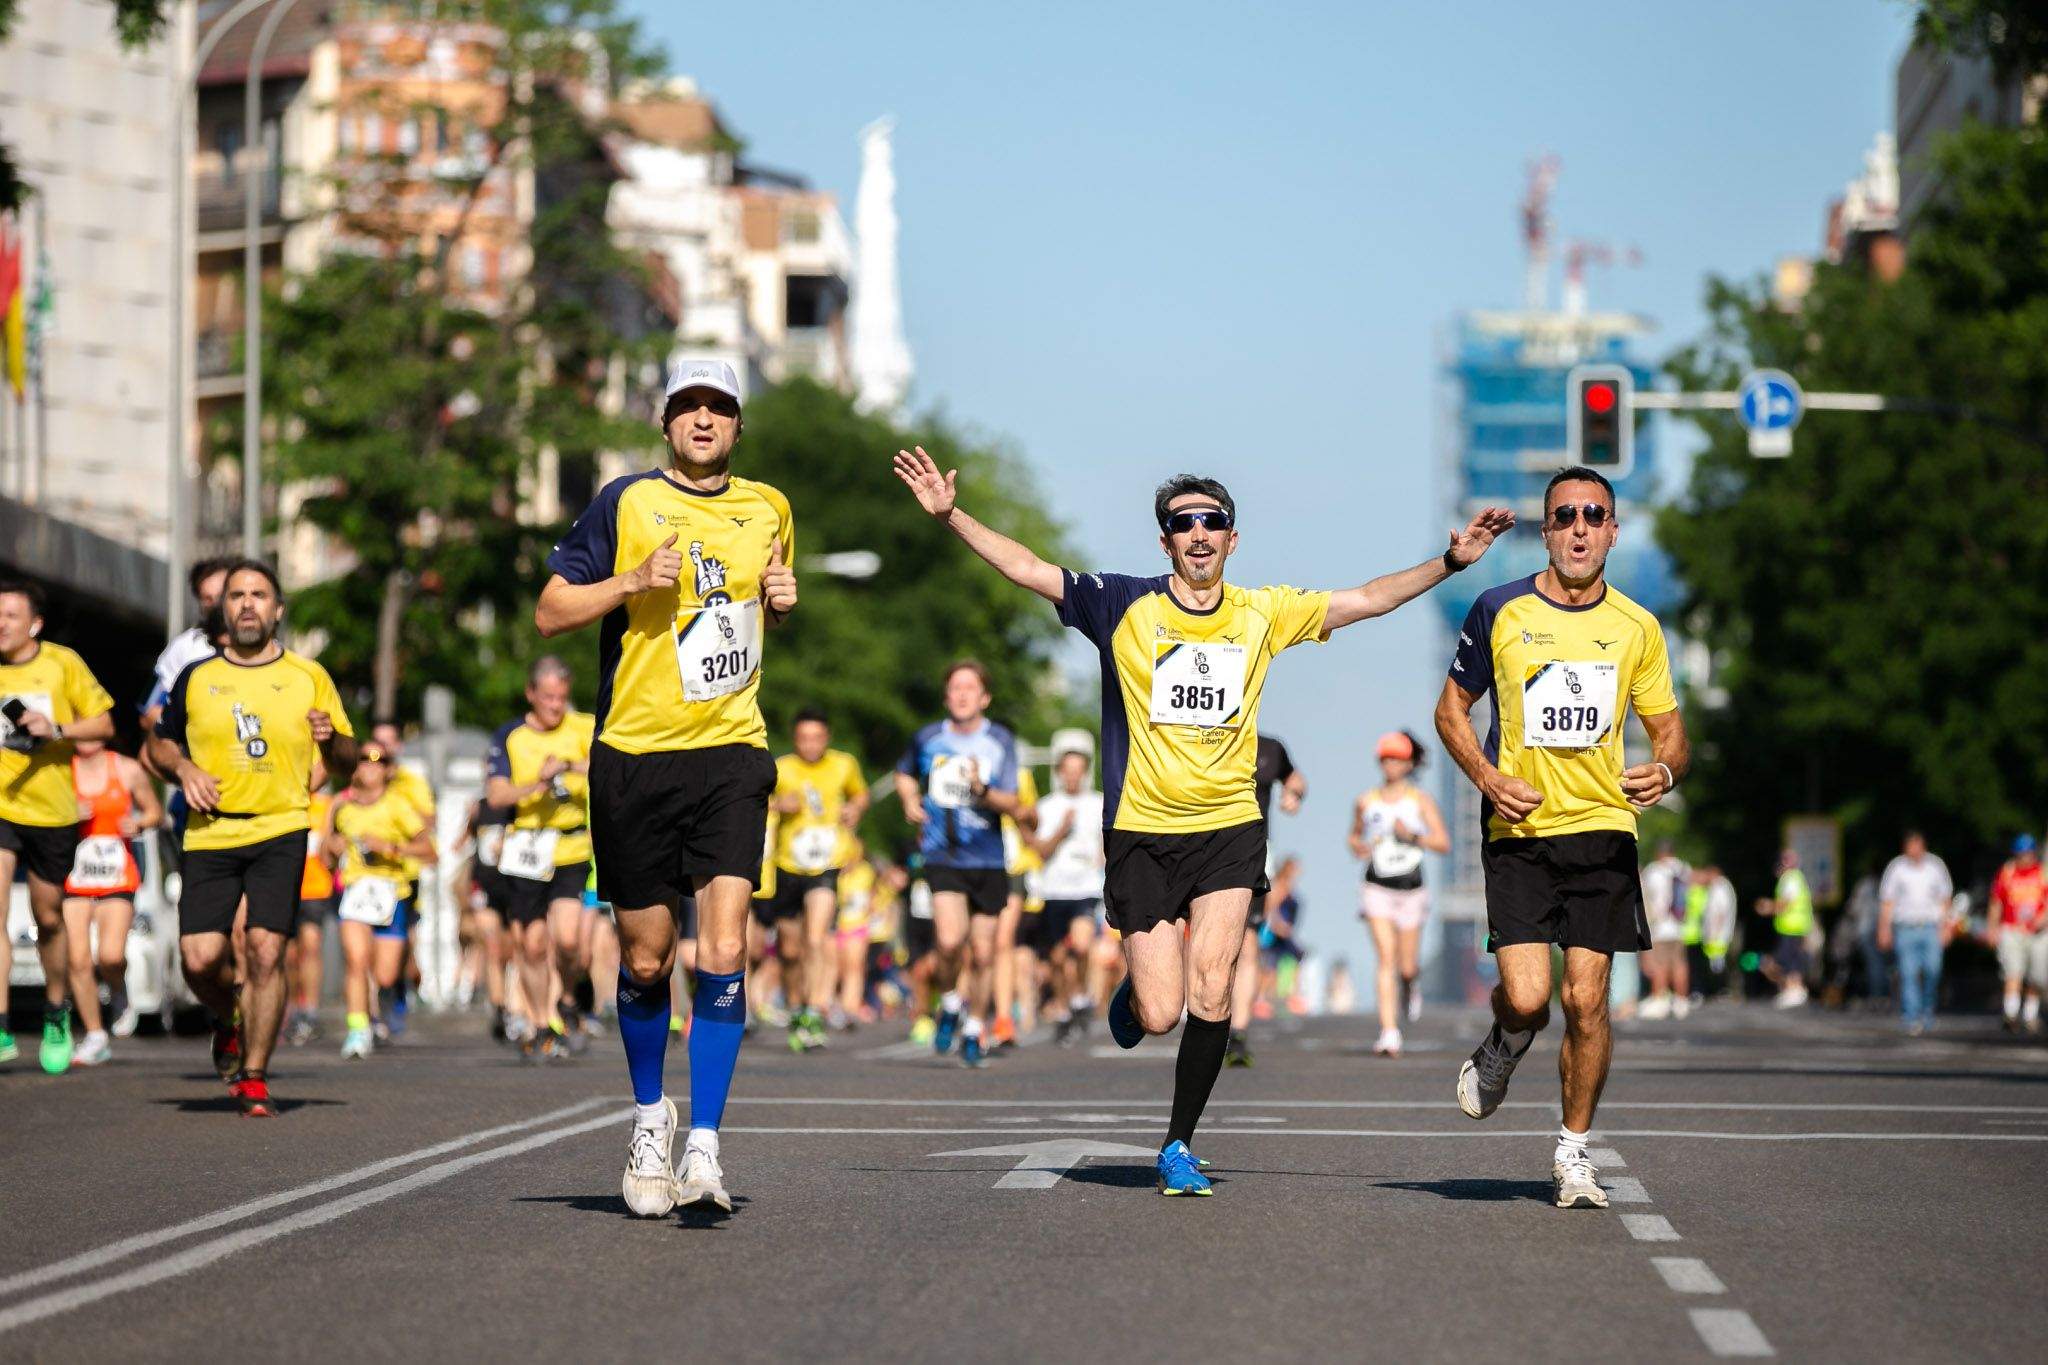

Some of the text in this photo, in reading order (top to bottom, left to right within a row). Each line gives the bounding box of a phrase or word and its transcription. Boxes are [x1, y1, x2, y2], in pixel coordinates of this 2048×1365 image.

[701, 647, 748, 683] 3201
[1171, 685, 1225, 711] 3851
[1542, 707, 1598, 731] 3879
[250, 741, 264, 756] 13
